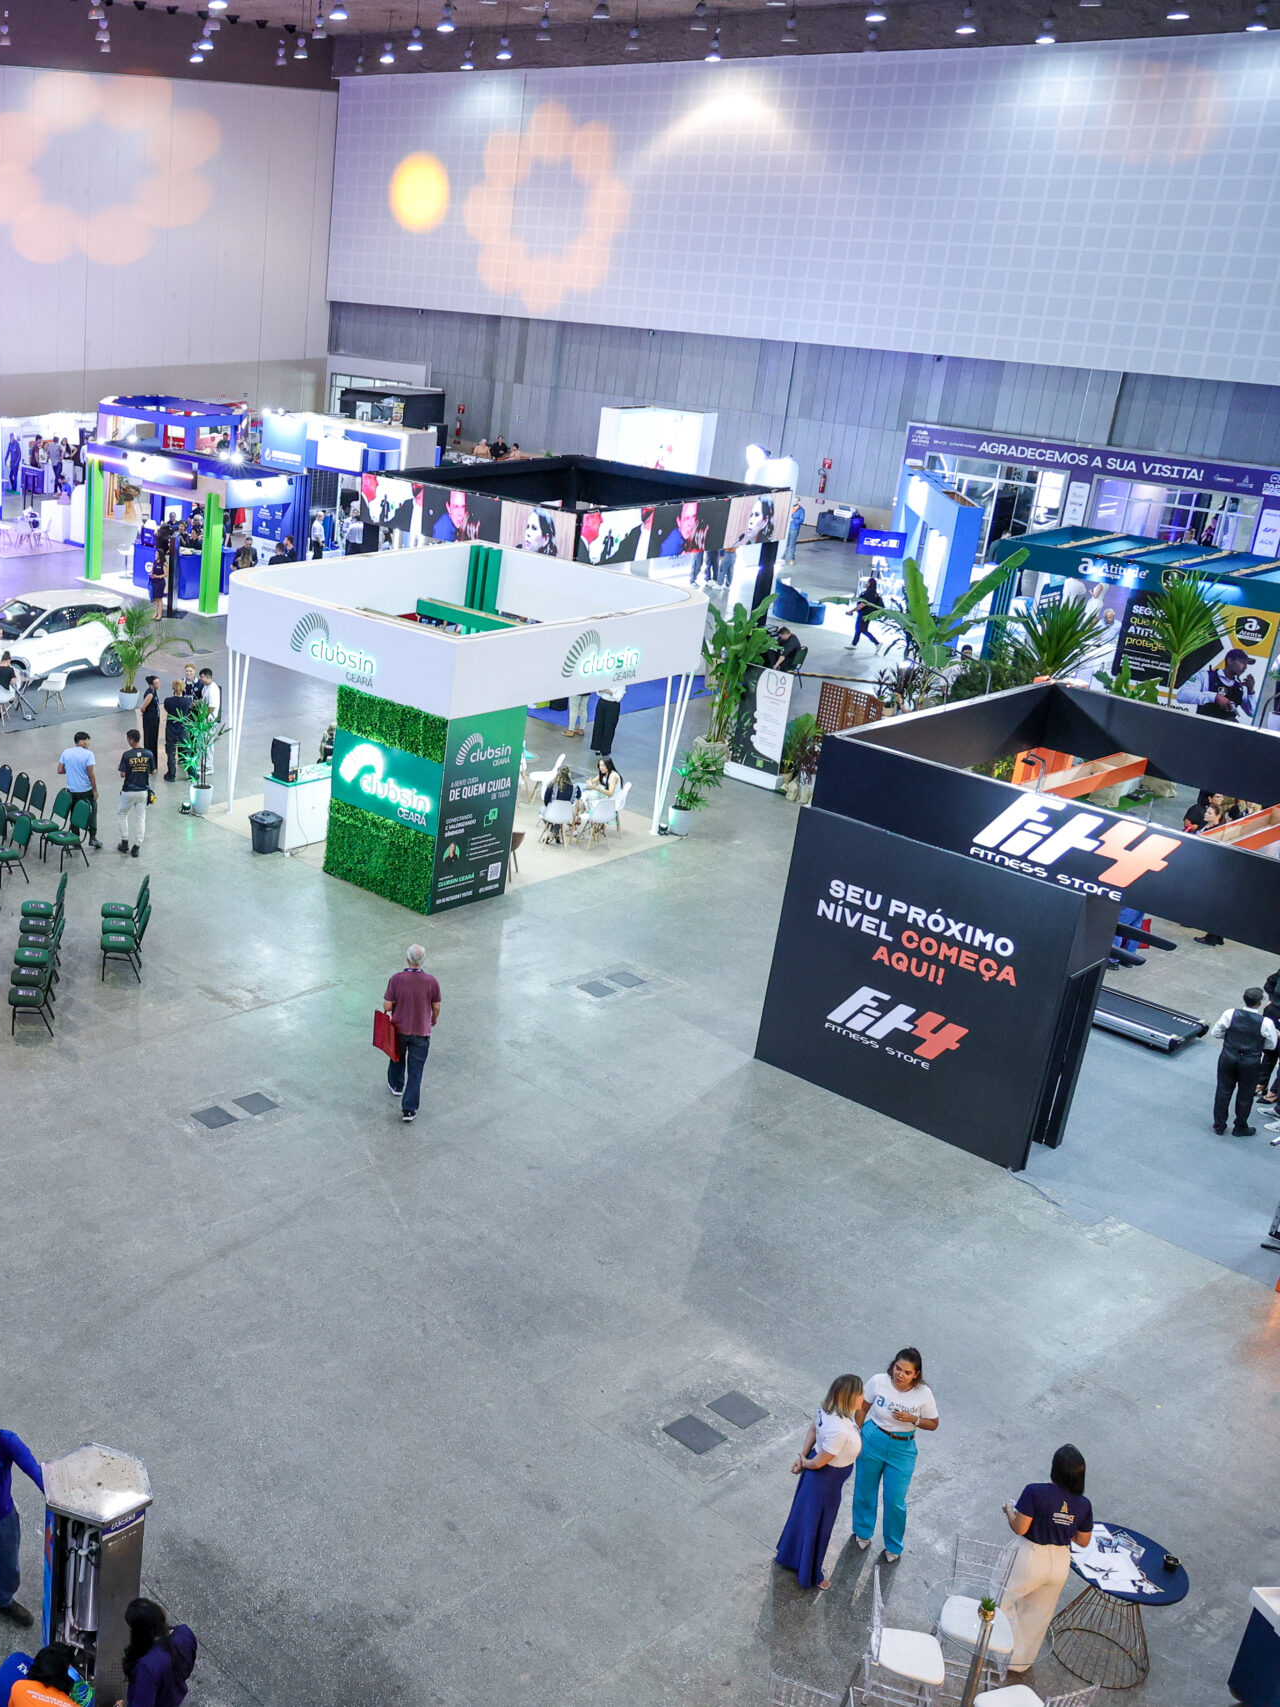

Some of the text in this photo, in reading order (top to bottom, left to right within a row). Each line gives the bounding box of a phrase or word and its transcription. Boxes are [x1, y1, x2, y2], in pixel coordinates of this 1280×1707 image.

[978, 441, 1205, 482] AGRADECEMOS A SUA VISITA!
[310, 639, 375, 675] clubsin
[581, 647, 640, 675] clubsin
[345, 670, 373, 688] CEARÁ
[470, 743, 511, 763] clubsin
[492, 756, 510, 767] CEARÁ
[359, 774, 432, 813] clubsin
[449, 776, 511, 802] DE QUEM CUIDA
[397, 806, 427, 827] CEARÁ
[829, 879, 1015, 957] SEU PRÓXIMO
[816, 899, 1017, 987] NÍVEL COMEÇA
[872, 945, 946, 985] AQUI!
